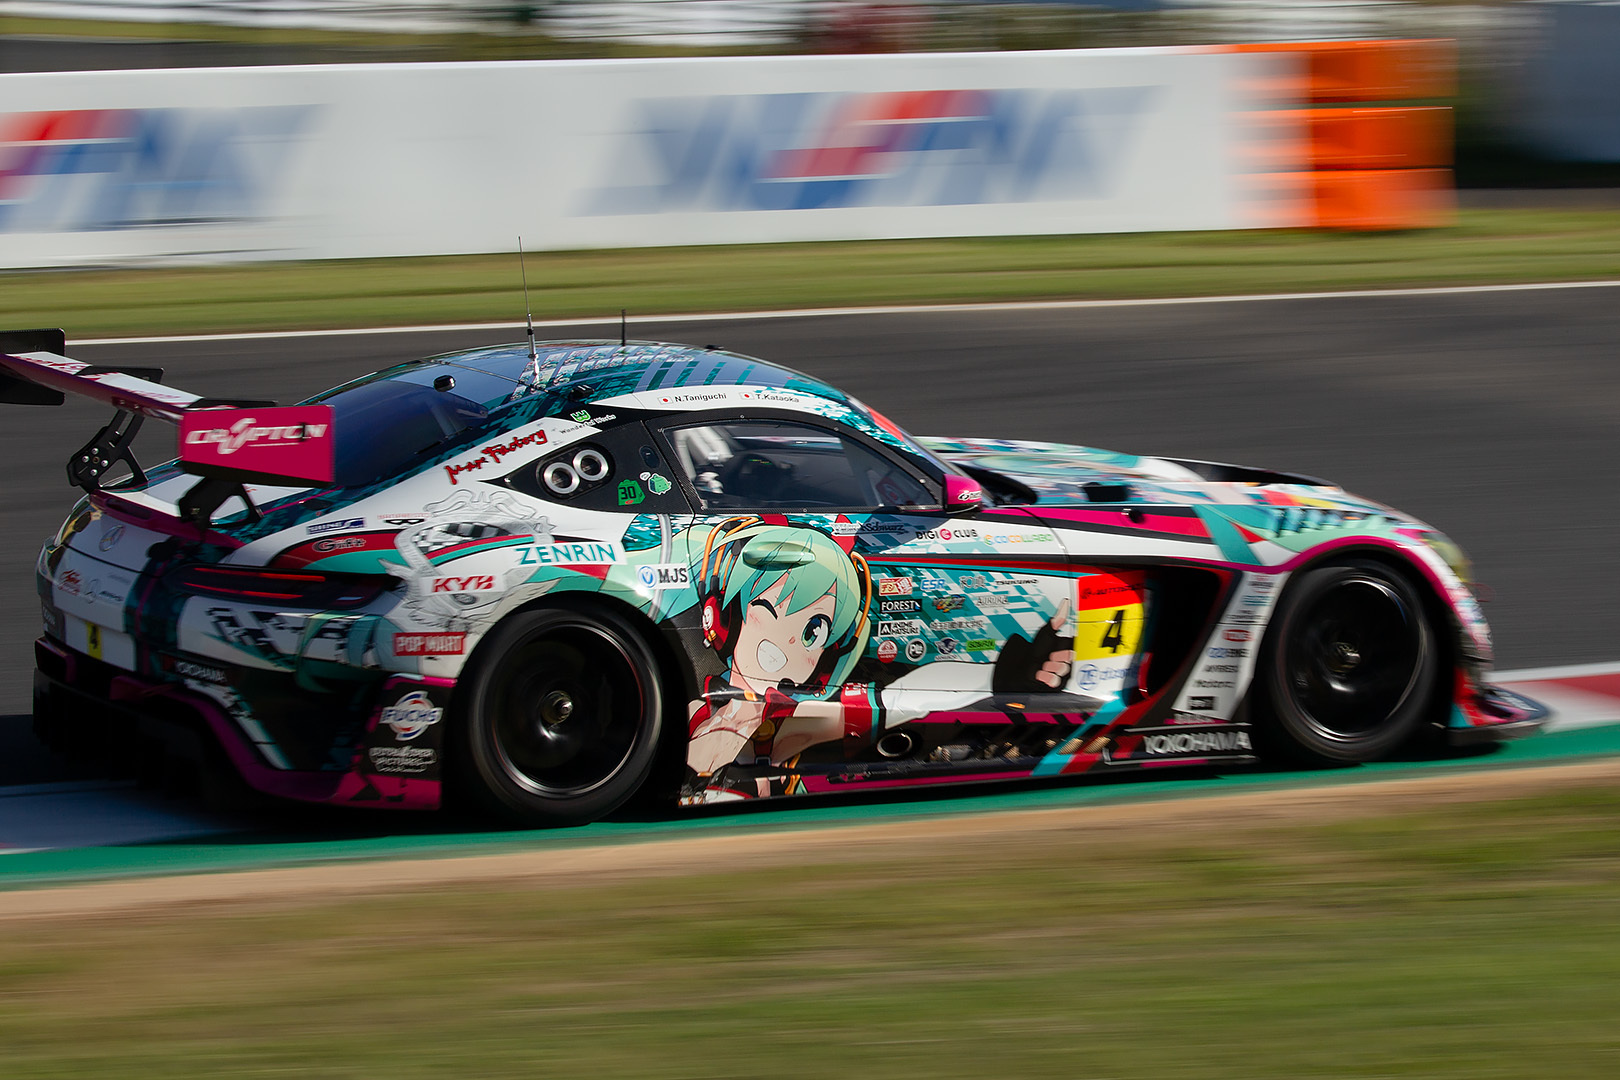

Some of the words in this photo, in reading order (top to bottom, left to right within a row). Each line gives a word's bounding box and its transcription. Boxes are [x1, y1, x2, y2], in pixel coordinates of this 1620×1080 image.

[675, 393, 727, 402] N.Taniguchi
[756, 393, 800, 403] T.Kataoka
[559, 418, 596, 434] Wonderful
[185, 417, 328, 454] CRYPTON
[481, 429, 548, 463] Factory
[619, 486, 636, 499] 30
[916, 530, 939, 540] DIGI
[953, 528, 978, 538] CLUB
[518, 543, 617, 565] ZENRIN
[433, 575, 494, 592] KYB
[659, 570, 688, 584] MJS
[921, 579, 945, 590] ESR
[881, 600, 915, 612] FOREST
[90, 624, 98, 650] 4
[1101, 610, 1124, 654] 4
[396, 636, 424, 653] POP
[425, 635, 463, 652] MART
[384, 708, 440, 722] FUCHS
[1143, 731, 1252, 754] YOKOHAMA
